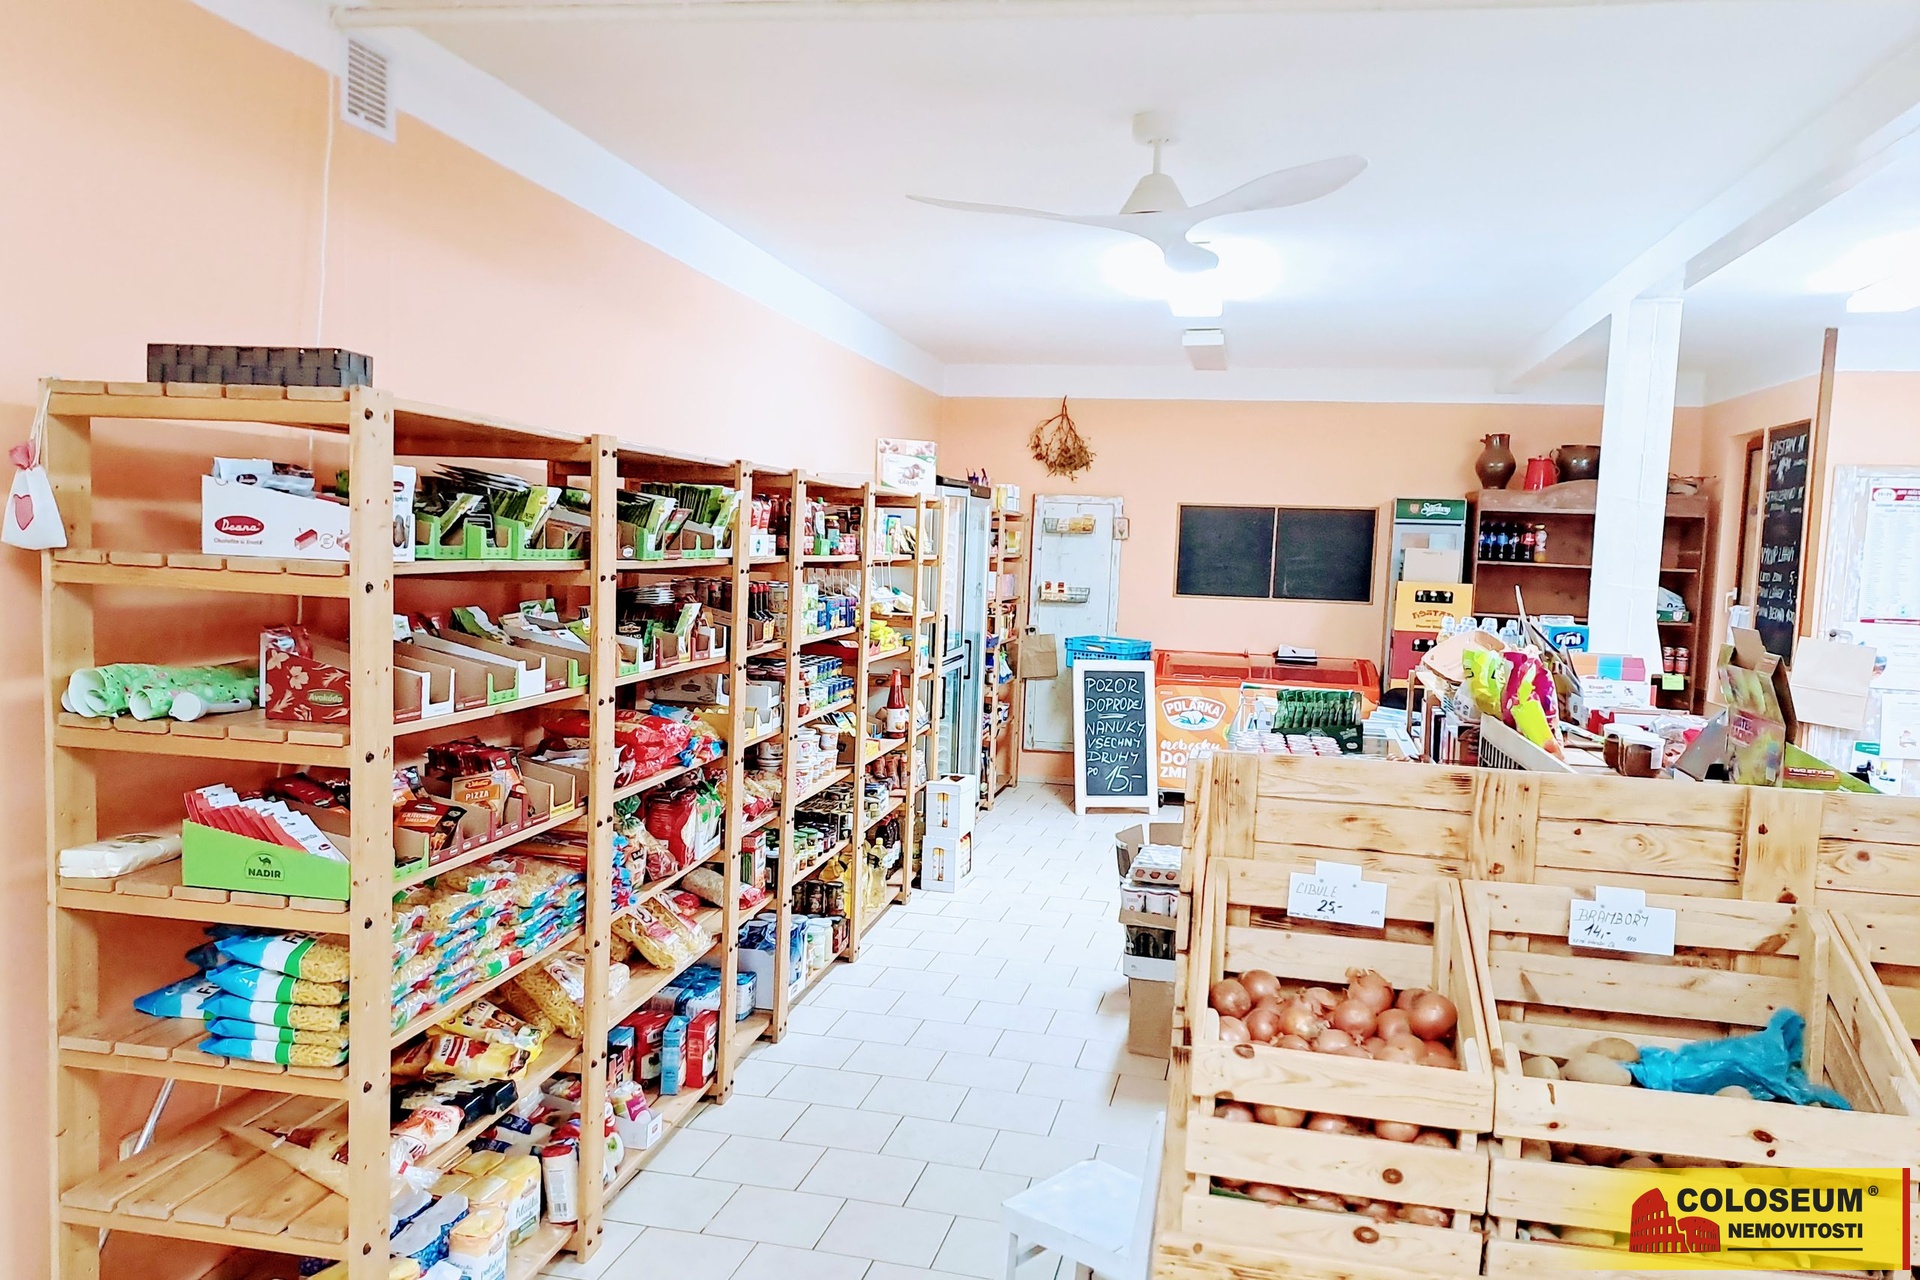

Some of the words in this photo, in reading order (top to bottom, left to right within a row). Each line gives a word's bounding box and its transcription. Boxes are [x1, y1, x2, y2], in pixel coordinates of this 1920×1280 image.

[1085, 678, 1140, 694] POZOR
[1085, 697, 1144, 712] DOPRODEJ
[1086, 720, 1146, 737] NANUKY
[1086, 750, 1139, 765] DRUHY
[465, 790, 489, 801] PIZZA
[248, 868, 281, 878] NADIR
[1296, 882, 1337, 898] CIBULE
[1574, 908, 1649, 927] BRAMBORY
